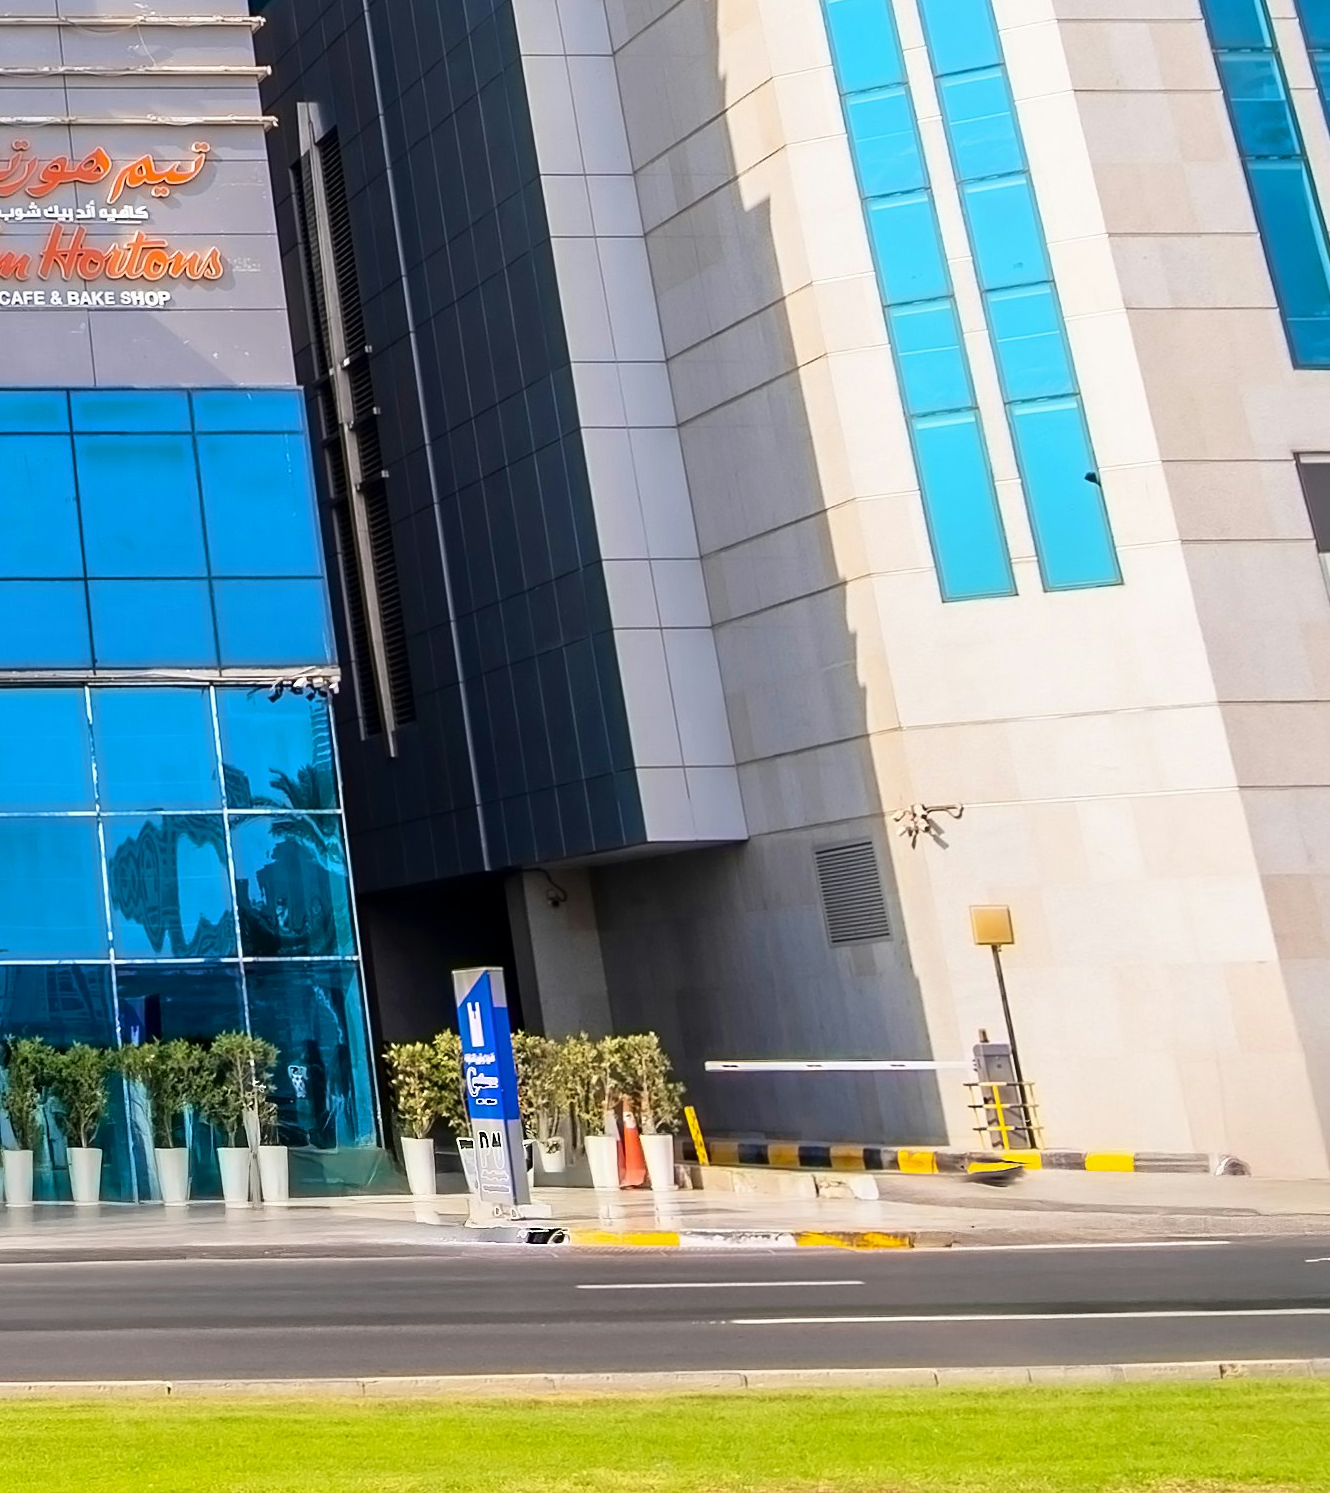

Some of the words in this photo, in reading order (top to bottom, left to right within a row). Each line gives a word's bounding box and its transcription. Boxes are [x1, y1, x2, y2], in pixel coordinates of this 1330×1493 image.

[106, 140, 212, 205] تيم
[98, 204, 149, 222] كافيه
[38, 223, 224, 282] Hortons
[50, 291, 63, 306] &
[67, 290, 116, 306] BAKE
[120, 290, 172, 308] SHOP
